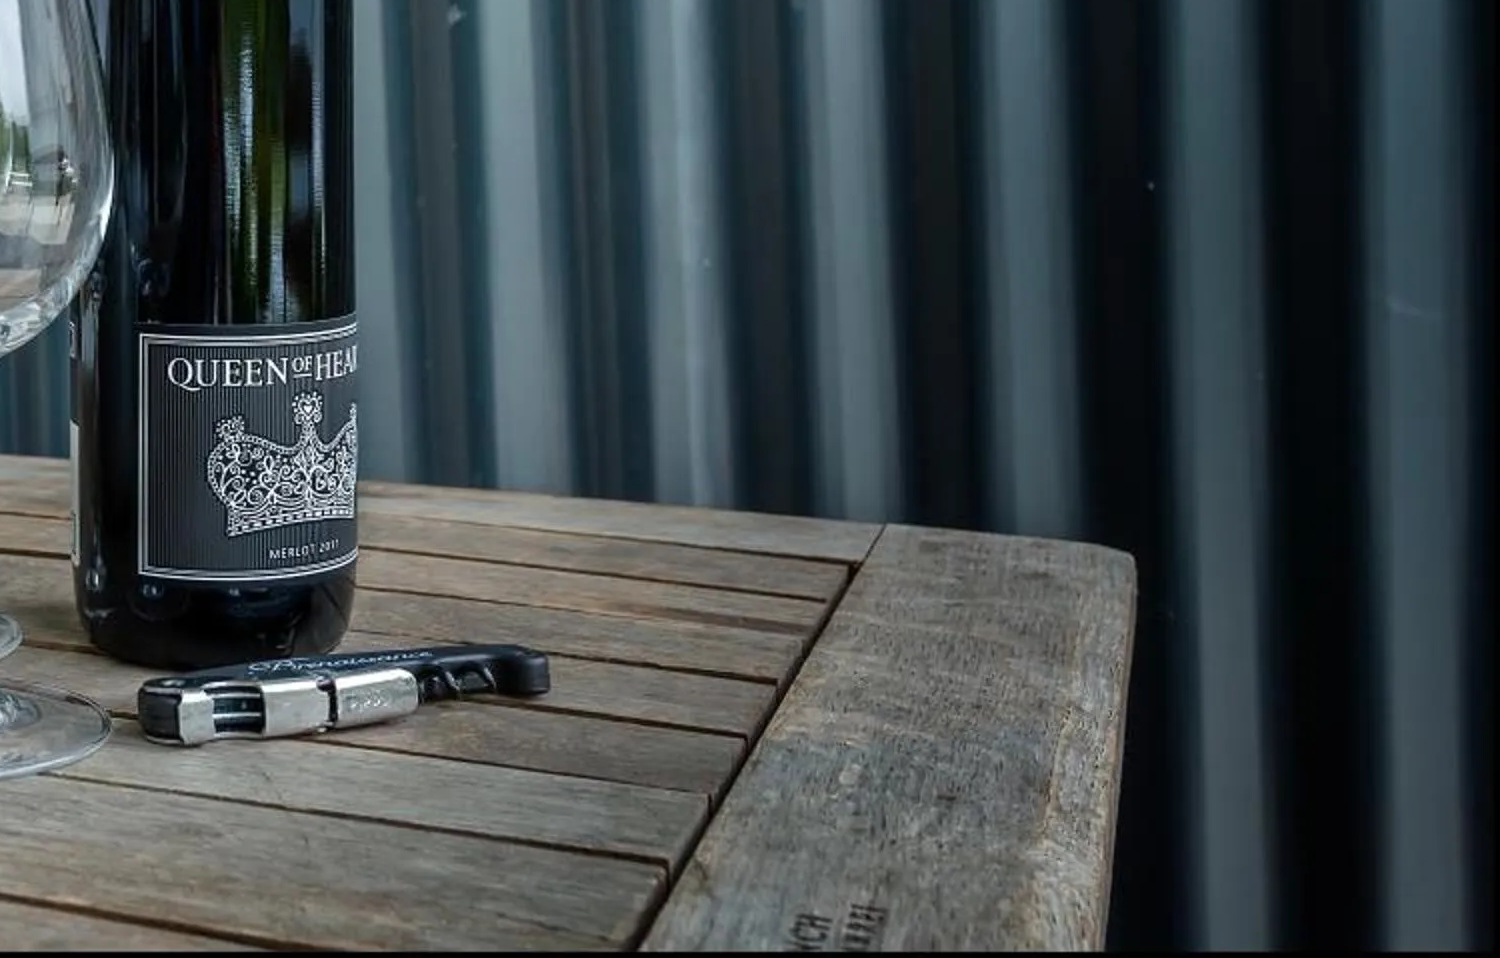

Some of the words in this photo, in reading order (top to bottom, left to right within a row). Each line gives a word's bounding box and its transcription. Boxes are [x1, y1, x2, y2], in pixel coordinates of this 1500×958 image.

[167, 357, 288, 391] QUEEN
[292, 355, 312, 373] OF
[269, 543, 315, 559] MERLOT
